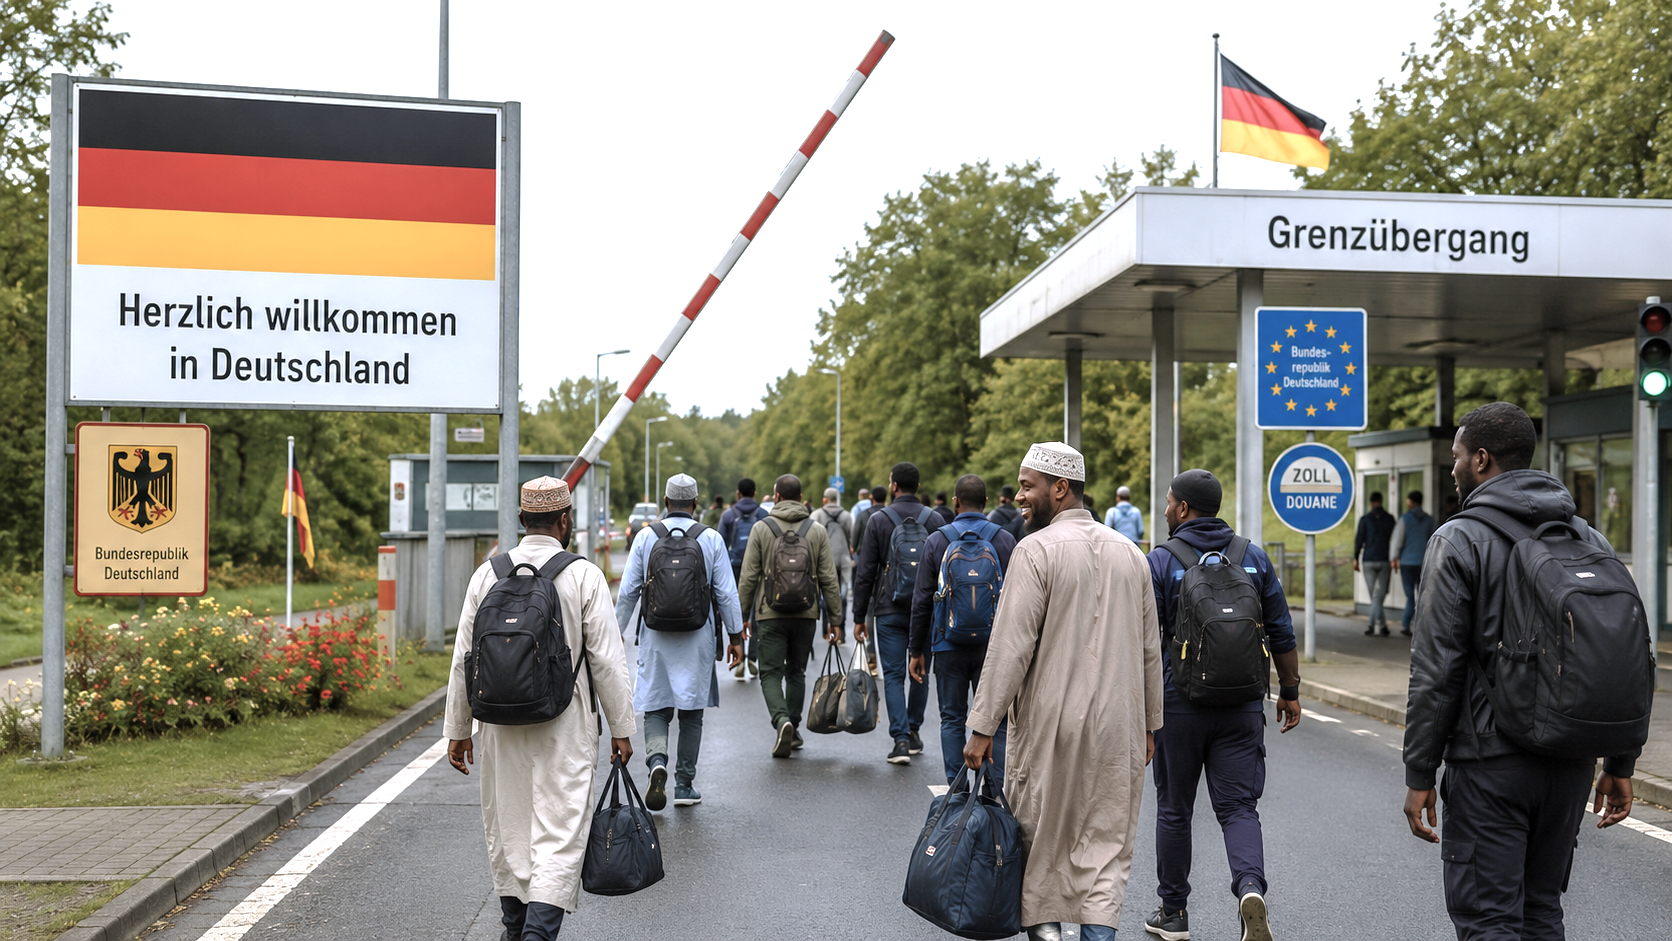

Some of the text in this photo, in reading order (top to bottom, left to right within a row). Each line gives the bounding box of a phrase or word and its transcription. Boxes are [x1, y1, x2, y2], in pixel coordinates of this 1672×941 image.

[1268, 215, 1530, 263] Grenzübergang
[120, 292, 456, 337] Herzlich willkommen
[1291, 345, 1332, 358] Bundes-
[170, 345, 410, 385] in Deutschland
[1292, 361, 1331, 376] republik
[1283, 376, 1339, 388] Deutschland
[1293, 468, 1331, 483] ZOLL
[1286, 495, 1337, 509] DOUANE
[95, 546, 189, 563] Bundesrepublik
[104, 566, 179, 580] Deutschland
